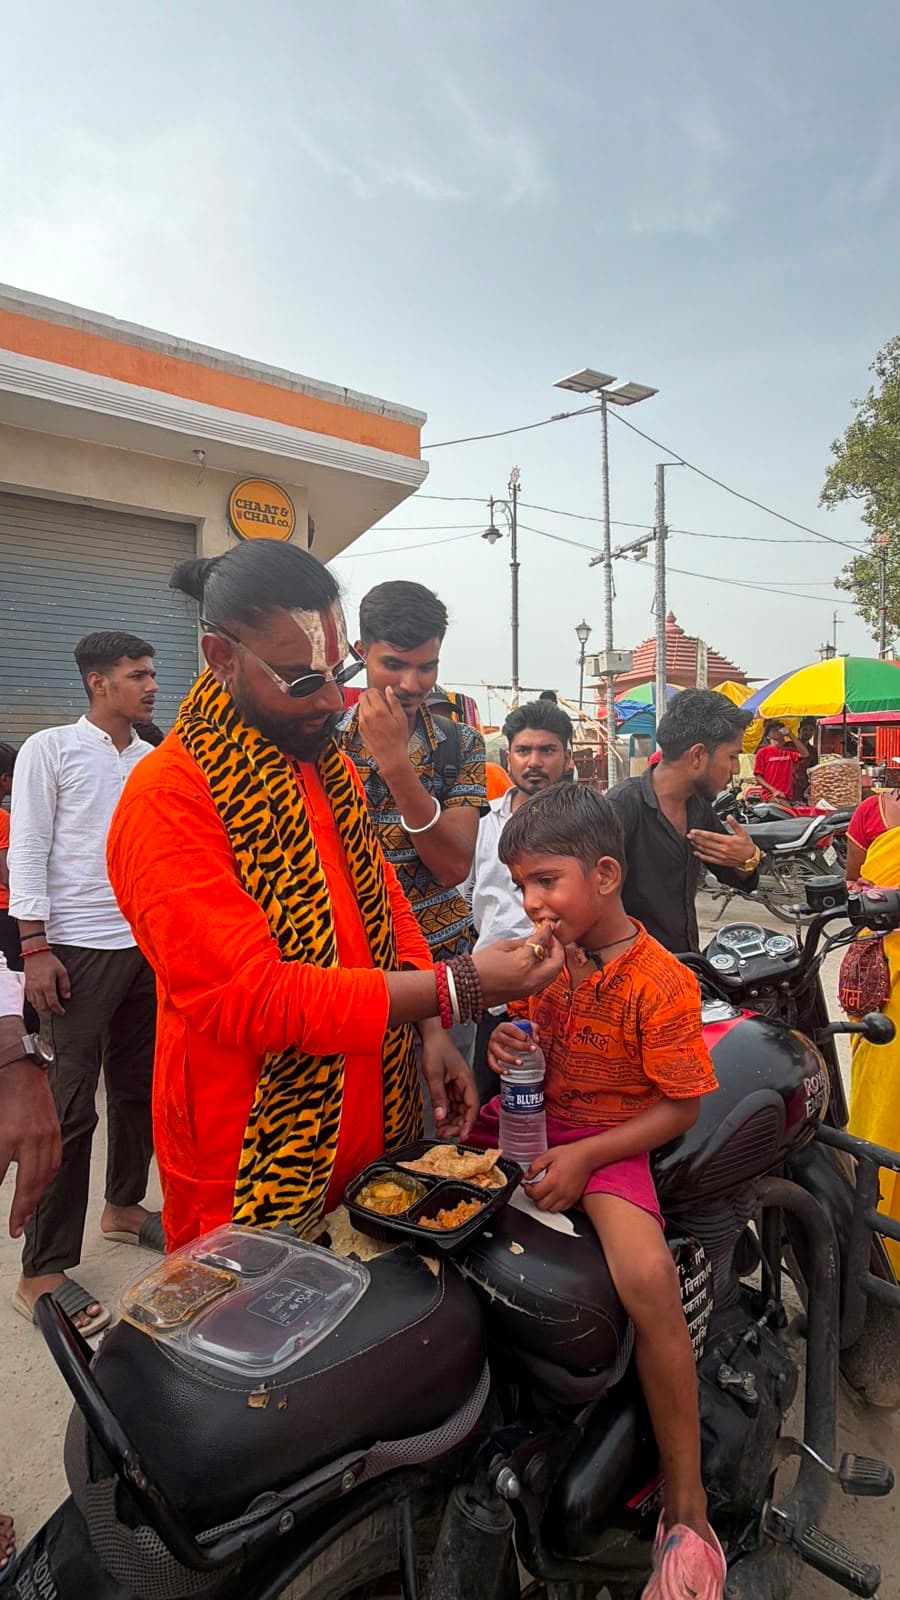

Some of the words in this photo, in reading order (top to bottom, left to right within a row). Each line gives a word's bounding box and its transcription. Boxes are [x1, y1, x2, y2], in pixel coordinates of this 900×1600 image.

[235, 499, 279, 515] CHAAT
[244, 511, 276, 525] CHAI
[841, 987, 863, 1010] राम
